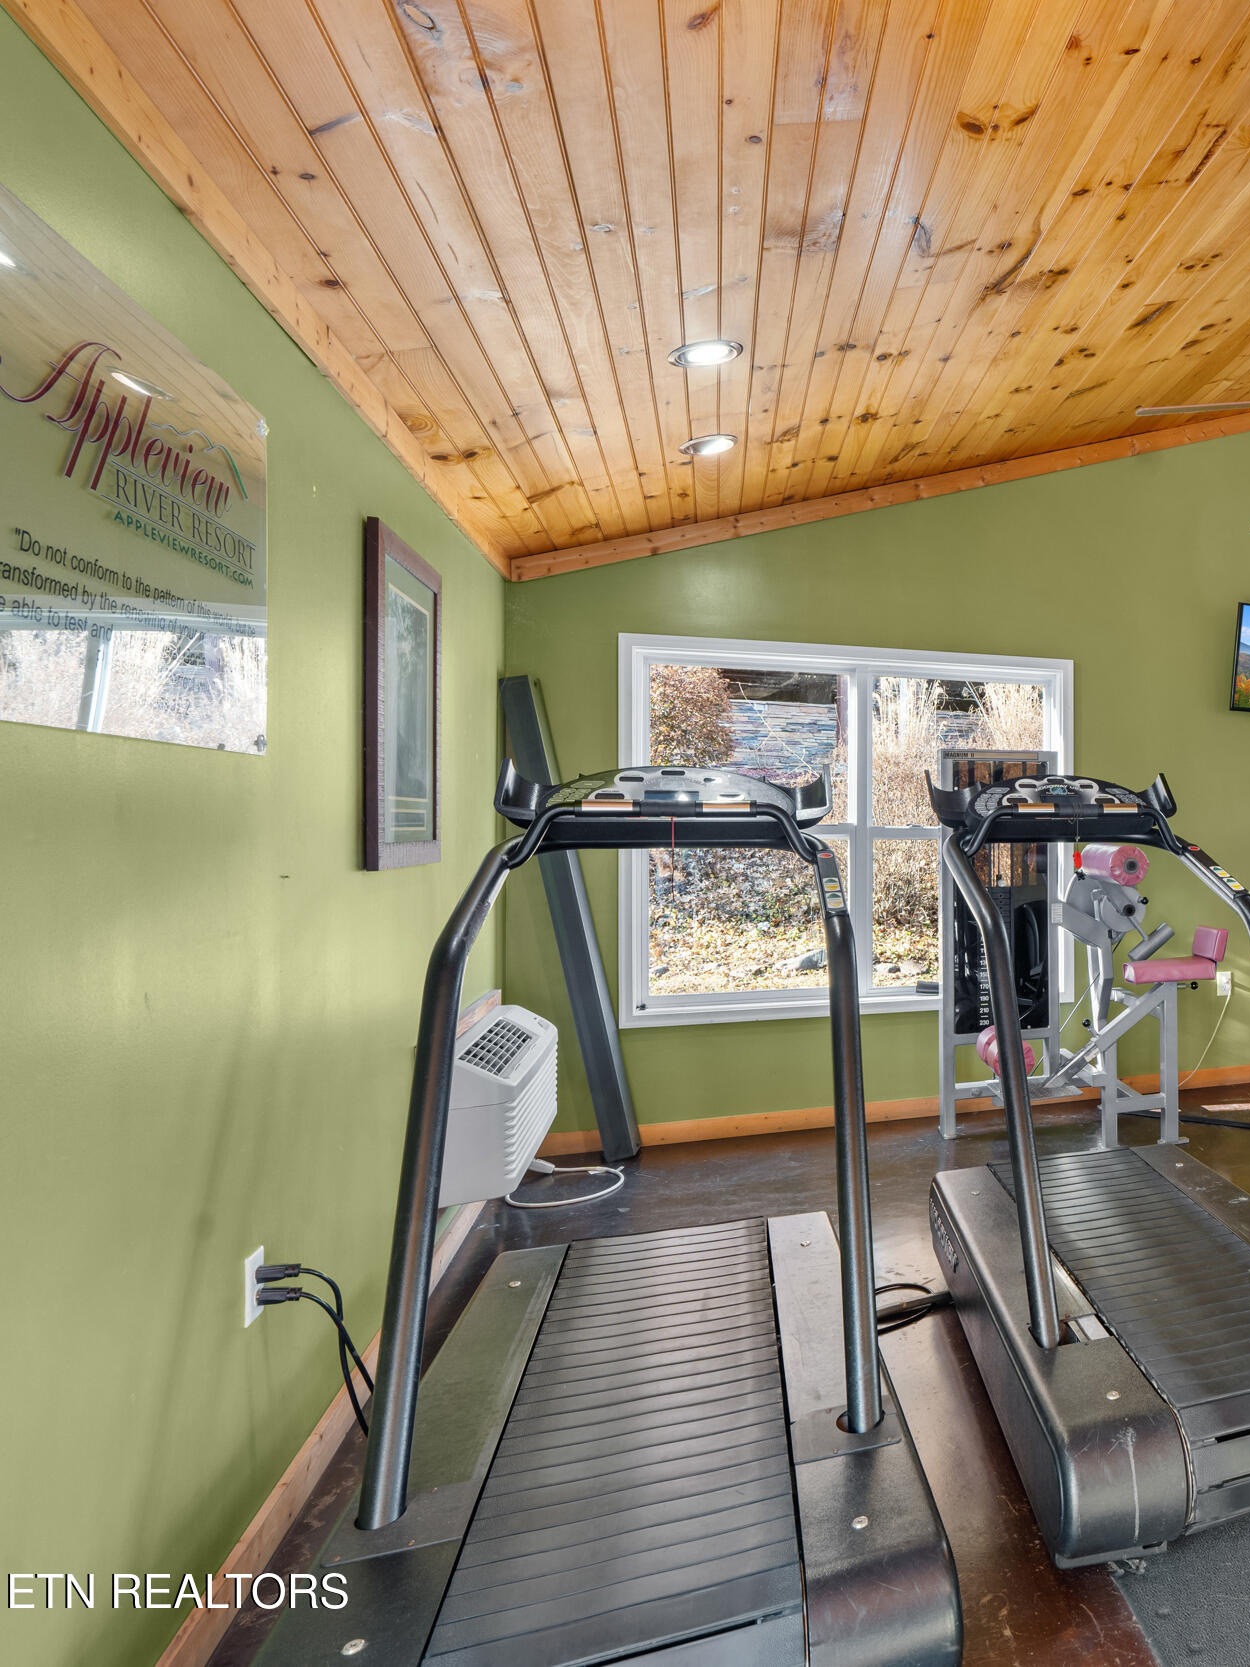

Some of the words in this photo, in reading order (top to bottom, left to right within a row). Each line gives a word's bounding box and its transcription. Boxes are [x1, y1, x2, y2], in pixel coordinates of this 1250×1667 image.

[0, 341, 232, 518] Appleview
[114, 510, 254, 589] APPLEVIEWRESORT.COM
[115, 468, 184, 533] RIVER
[192, 511, 256, 571] RESORT
[0, 562, 78, 601] ansformed
[82, 585, 96, 611] by
[100, 591, 117, 611] the
[168, 618, 177, 633] of
[15, 527, 41, 556] "Do
[46, 545, 67, 566] not
[71, 555, 118, 586] conform
[122, 571, 132, 590] to
[136, 576, 150, 598] the
[153, 587, 185, 612] pattern
[187, 599, 197, 614] of
[197, 601, 211, 621] this
[11, 596, 42, 622] able
[48, 606, 60, 627] to
[65, 611, 87, 632] test
[91, 623, 113, 642] and
